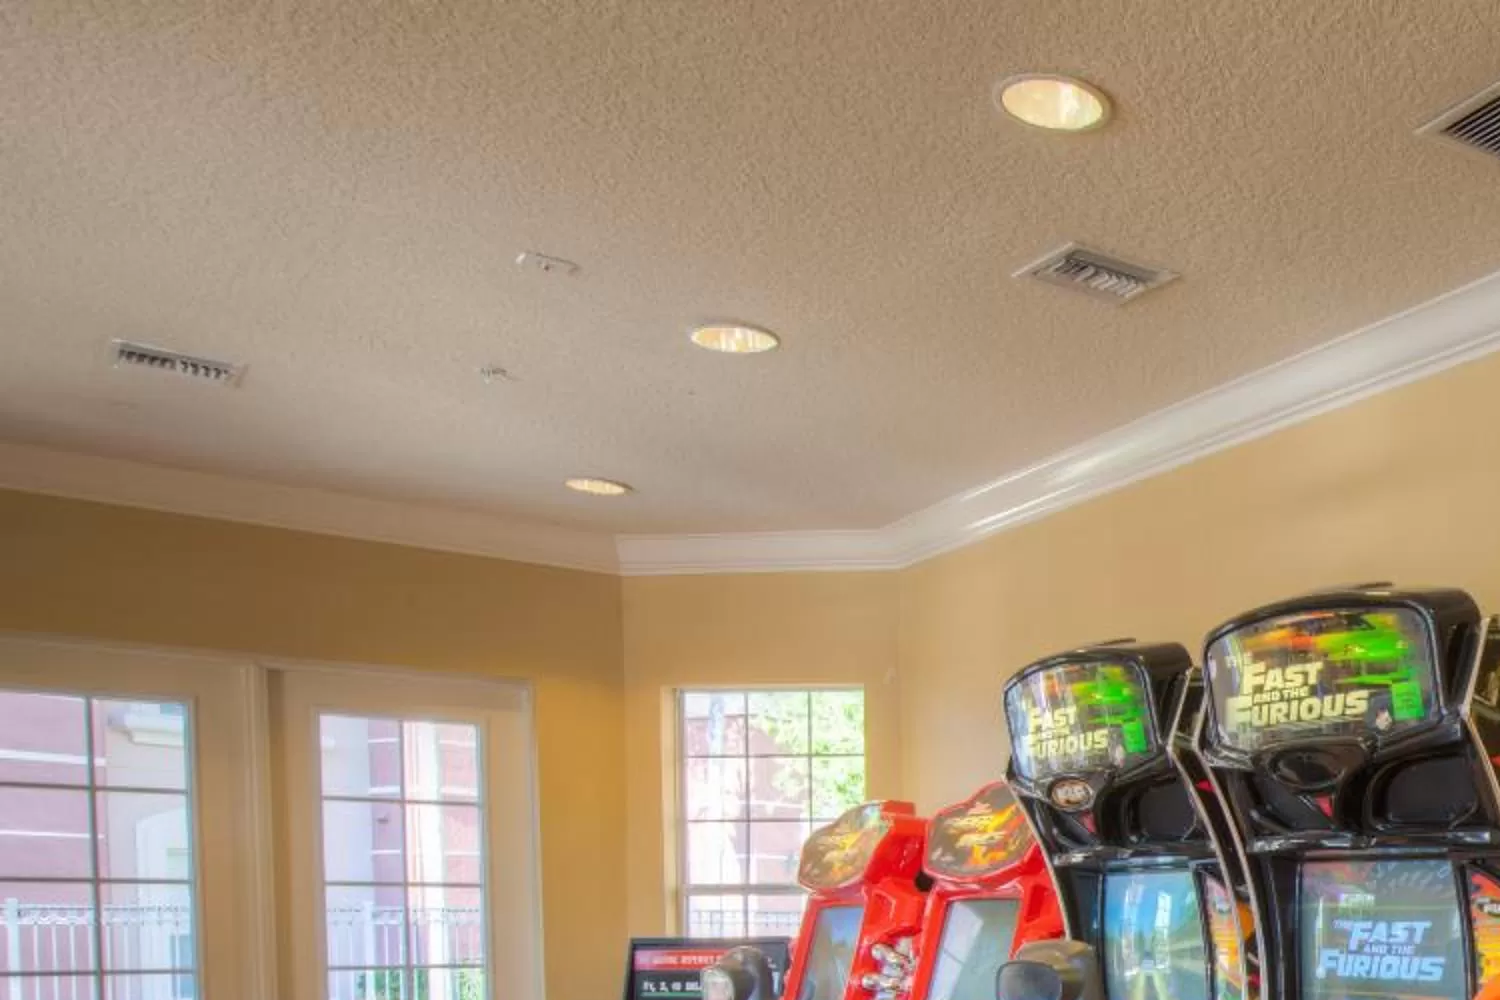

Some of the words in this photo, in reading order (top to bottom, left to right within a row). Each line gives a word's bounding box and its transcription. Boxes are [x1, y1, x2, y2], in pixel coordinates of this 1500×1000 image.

[1243, 661, 1325, 695] FAST
[1029, 704, 1077, 735] FAST
[1226, 689, 1370, 733] FURIOUS
[1023, 729, 1109, 760] FURIOUS
[1350, 920, 1433, 953] FAST
[1320, 948, 1445, 981] FURIOUS
